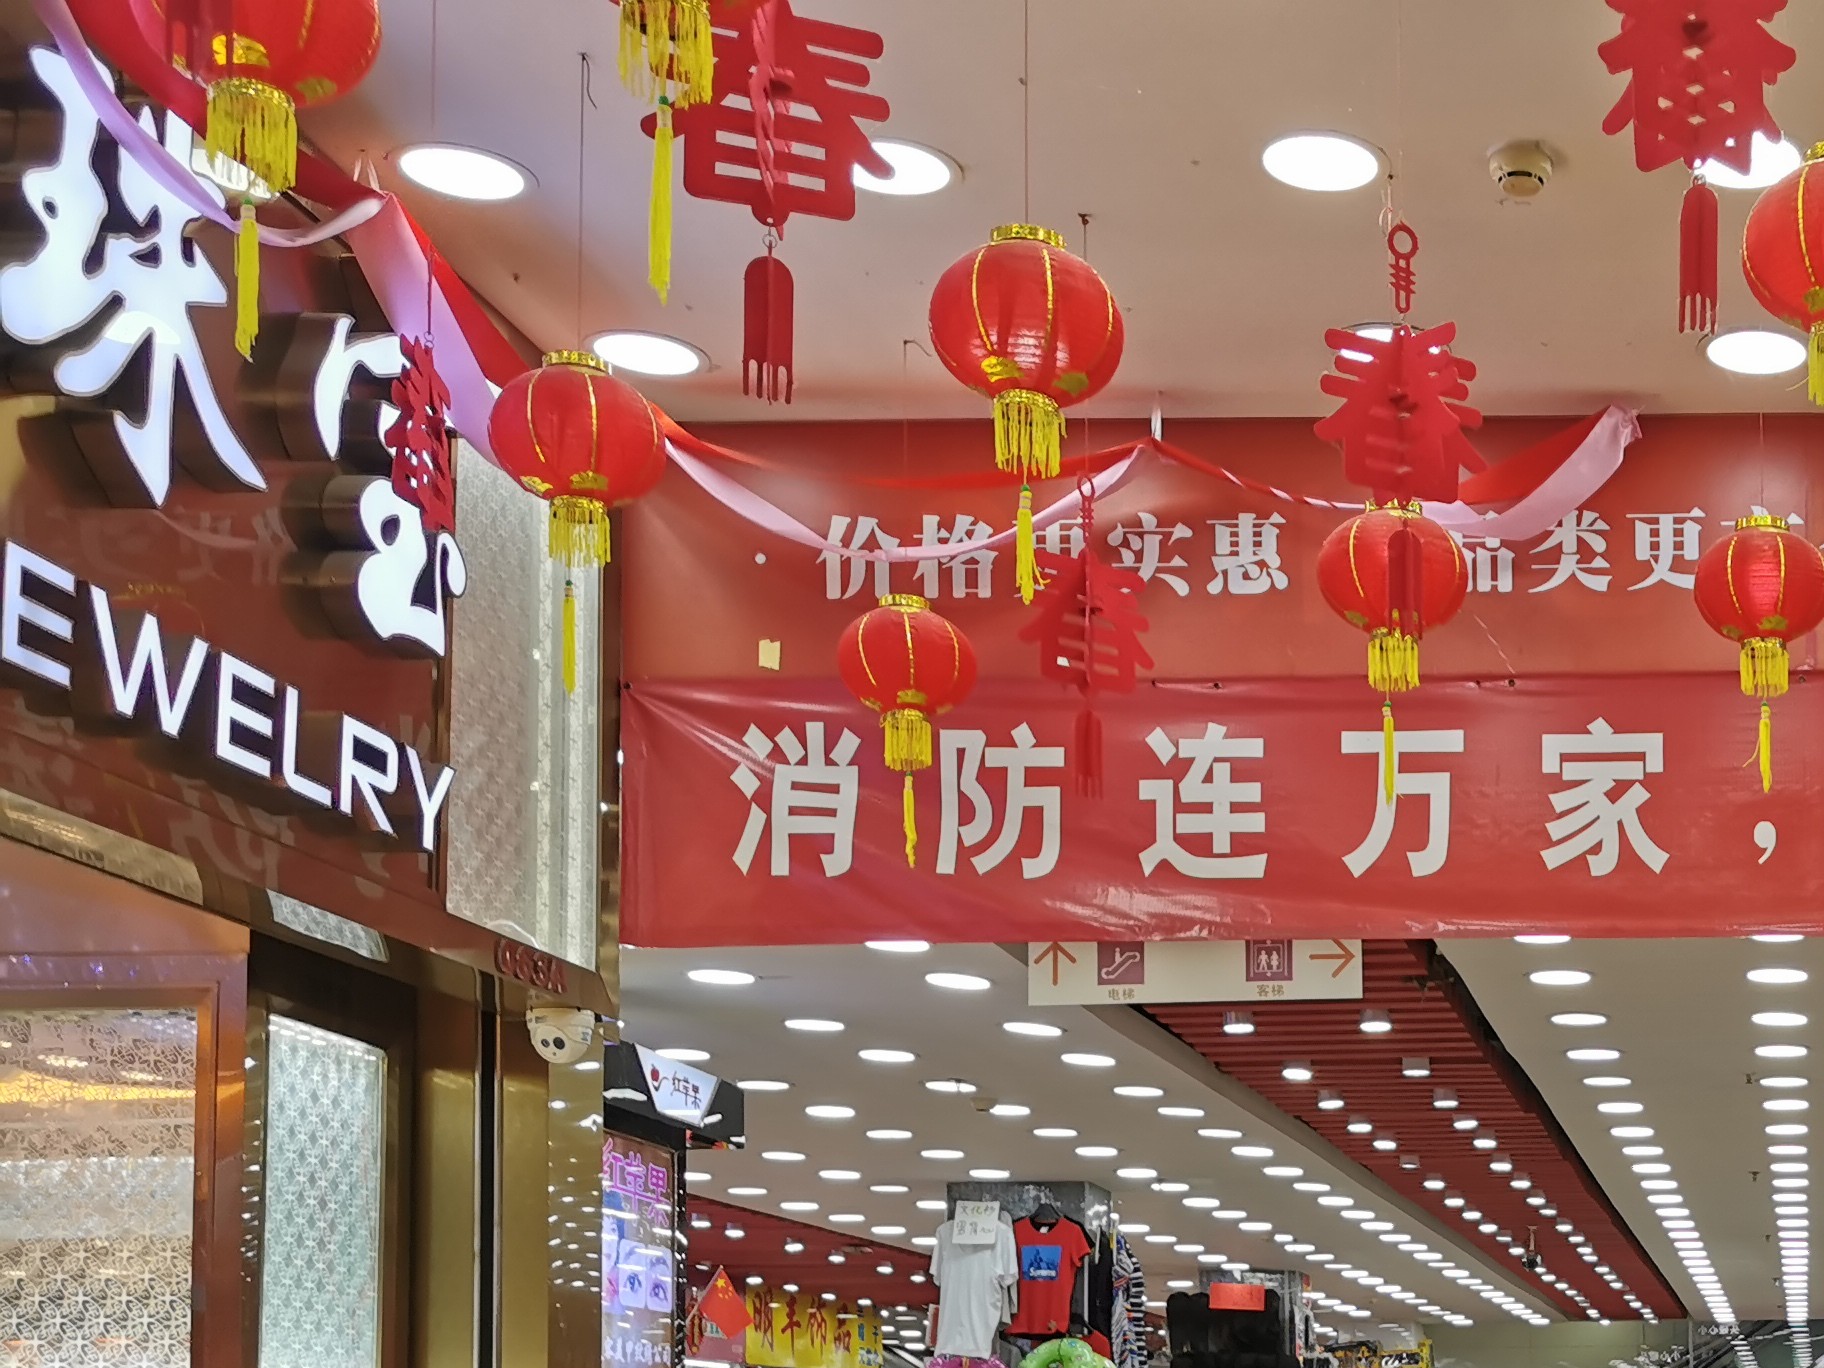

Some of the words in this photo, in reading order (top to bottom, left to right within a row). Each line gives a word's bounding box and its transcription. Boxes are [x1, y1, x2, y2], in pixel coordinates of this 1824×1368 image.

[2, 538, 458, 853] EWELRY
[1107, 987, 1136, 1001] 电梯
[1256, 984, 1285, 997] 客梯
